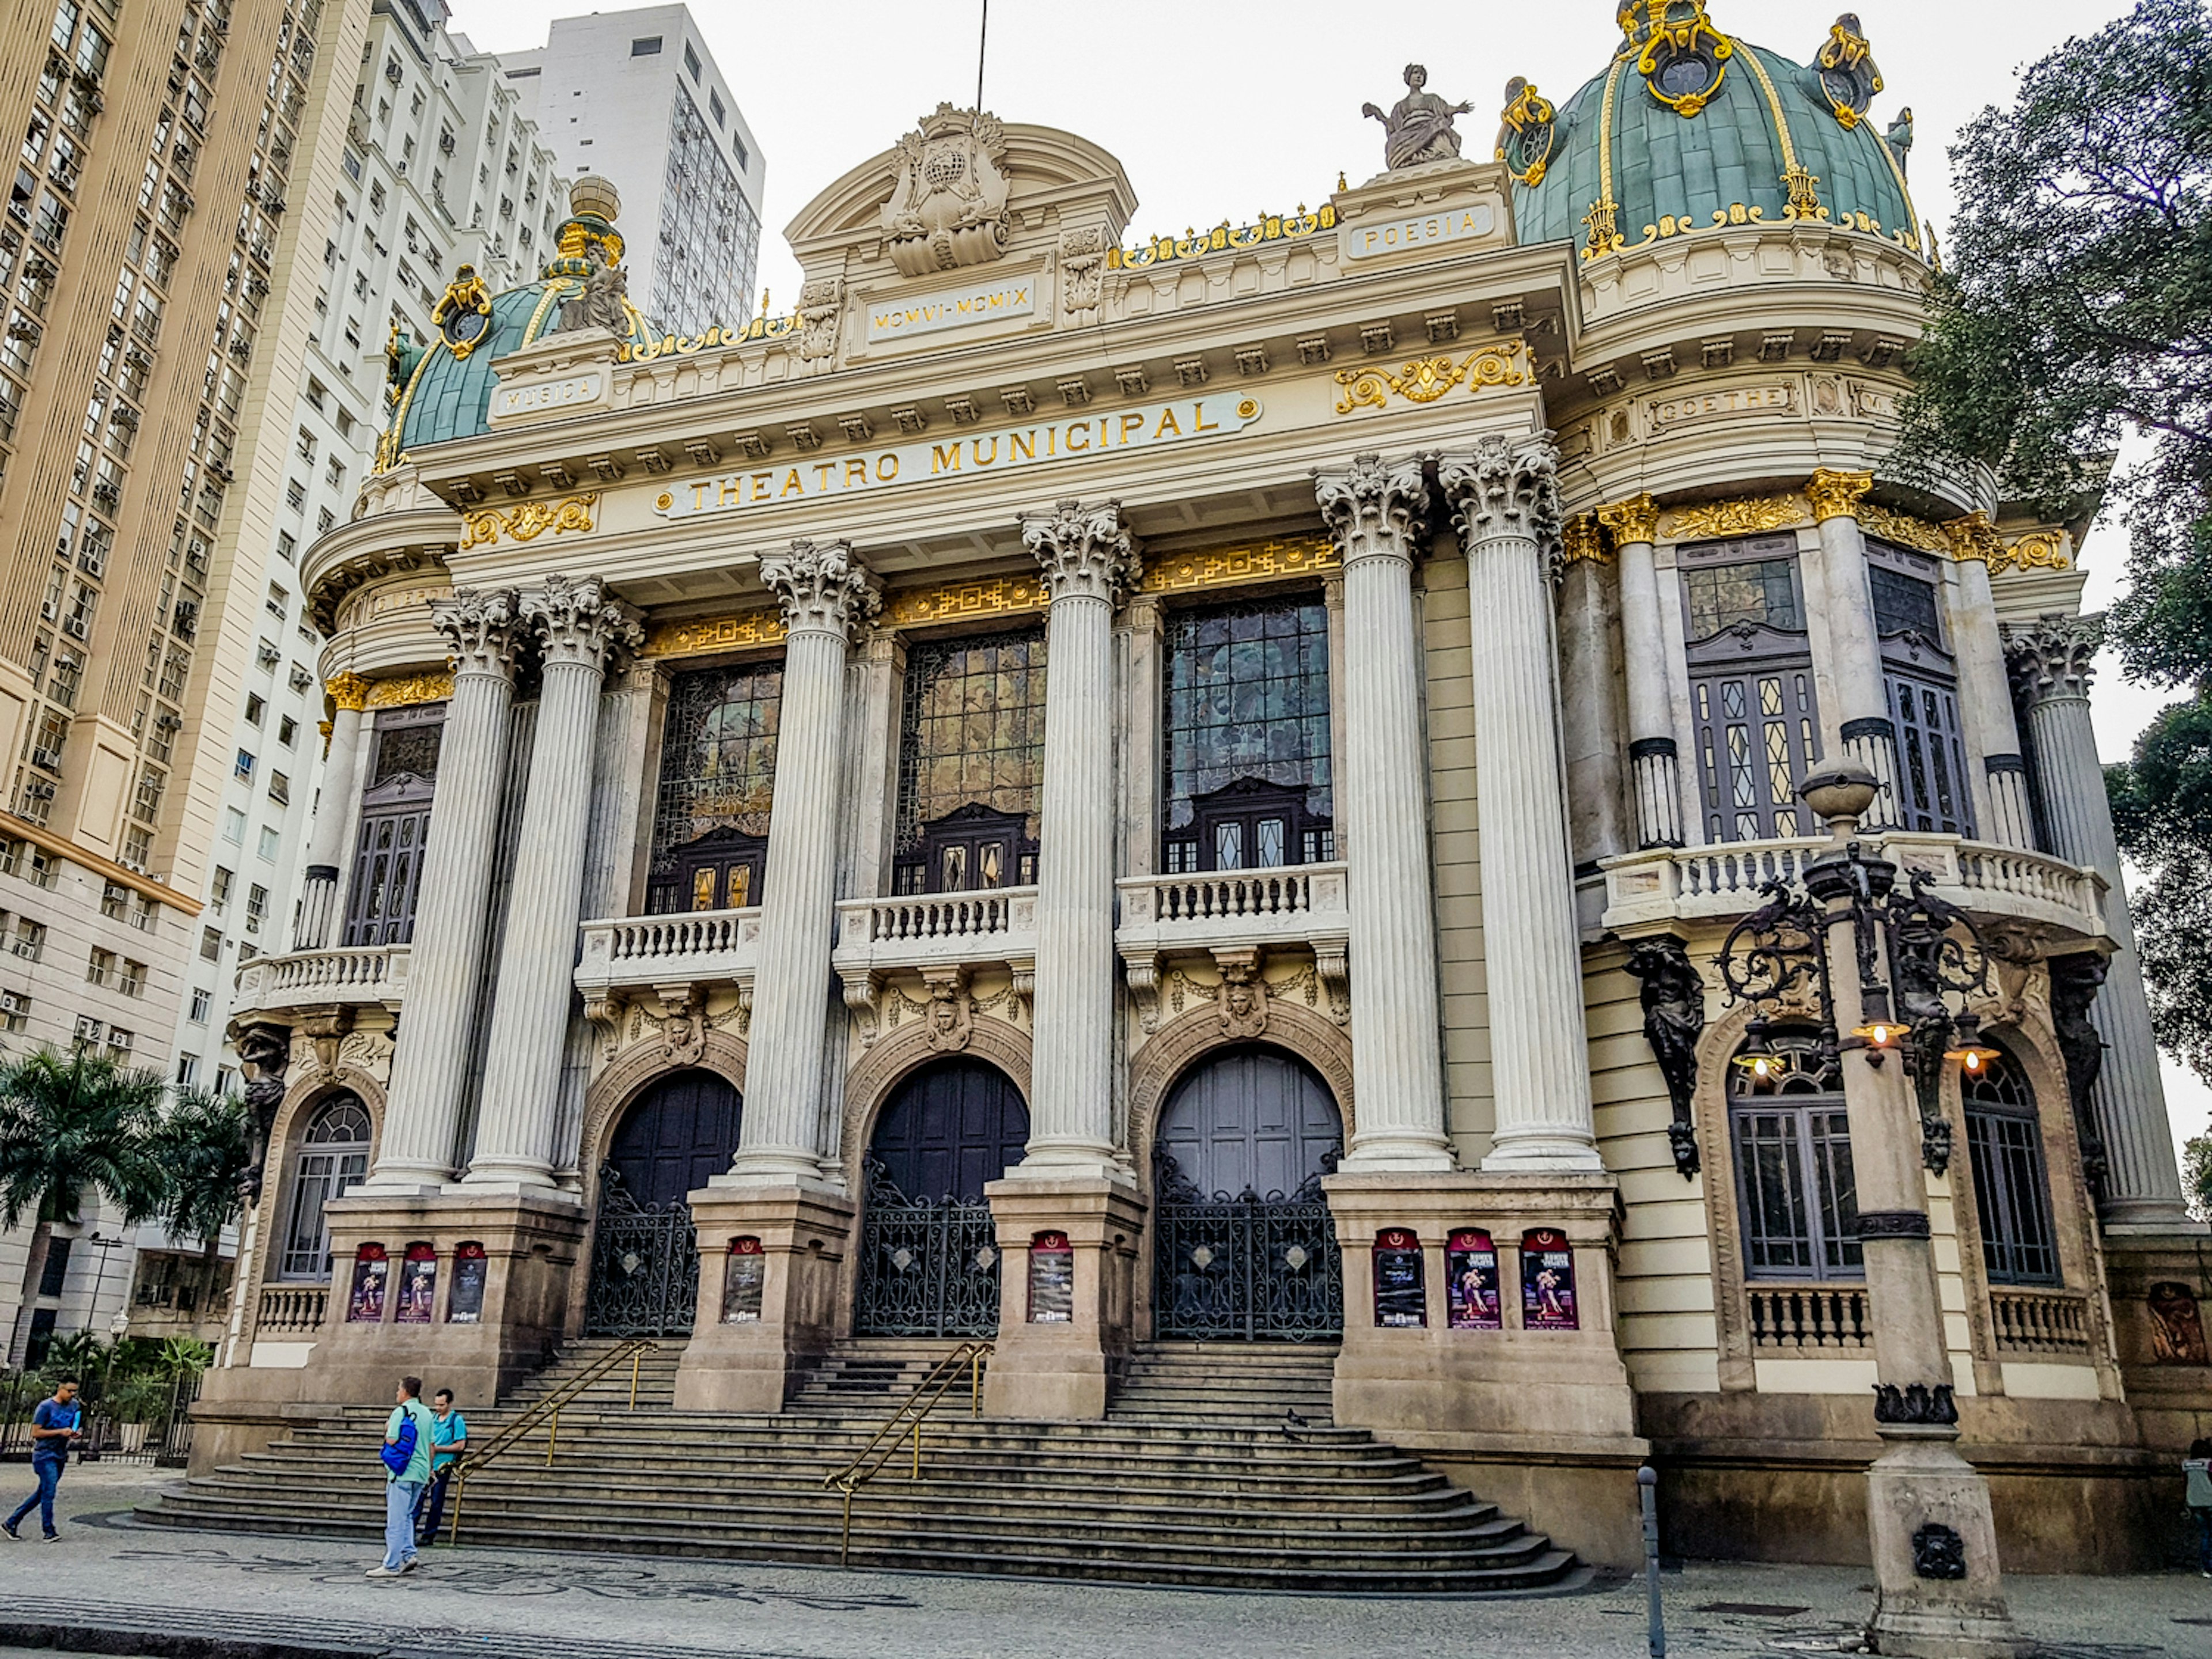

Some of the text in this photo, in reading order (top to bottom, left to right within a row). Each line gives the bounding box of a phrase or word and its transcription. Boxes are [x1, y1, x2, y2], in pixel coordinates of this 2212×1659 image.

[1365, 213, 1476, 250] POESIA
[874, 287, 1028, 330] MCMVI-MCMIX
[506, 380, 589, 409] MUSICA
[1663, 389, 1781, 419] GOETHE
[689, 403, 1219, 510] THEATRO MUNICIPAL
